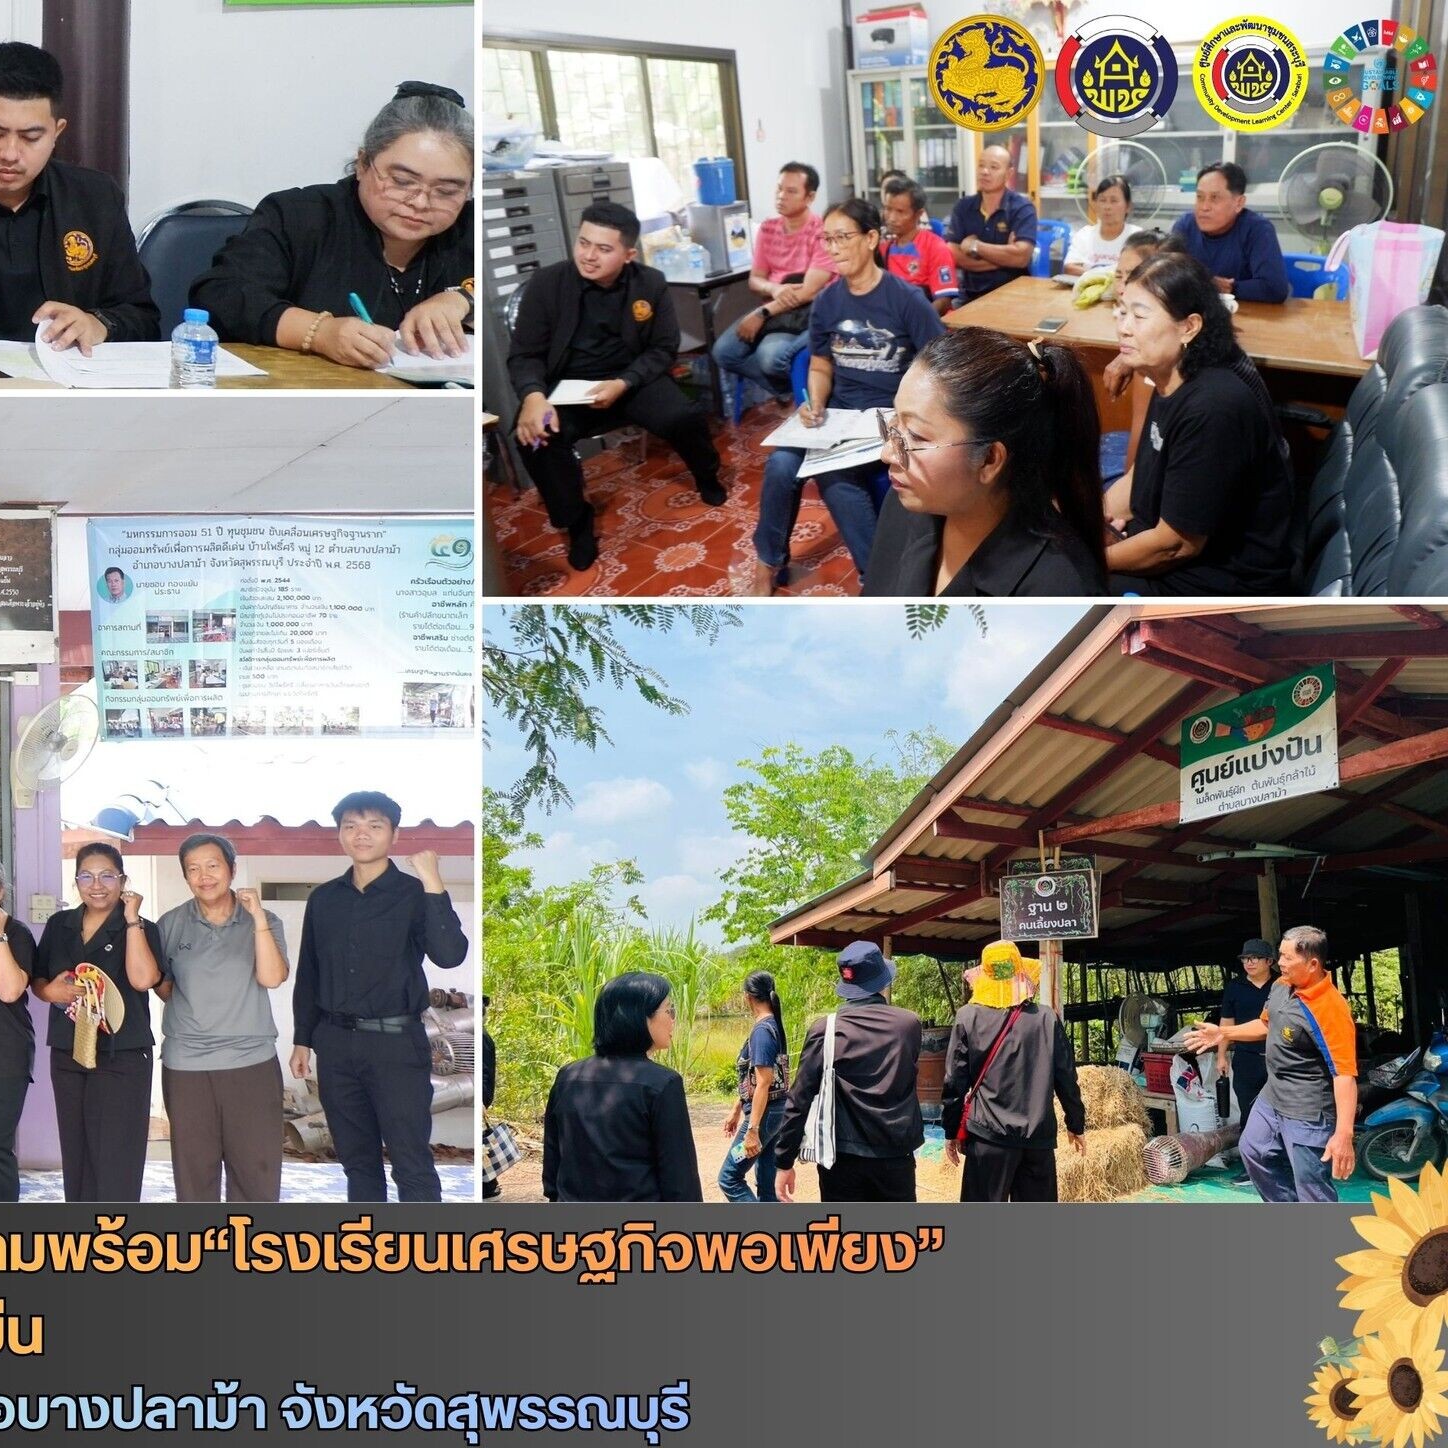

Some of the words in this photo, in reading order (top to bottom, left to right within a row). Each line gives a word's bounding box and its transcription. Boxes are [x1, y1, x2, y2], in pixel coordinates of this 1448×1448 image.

[216, 526, 224, 537] ปี
[226, 527, 265, 541] ทุนชุมชน
[108, 542, 246, 556] กลุ่มออมทรัพย์เพื่อการผลิตดีเด่น
[249, 538, 295, 552] บ้านโพธิ์ศรี
[298, 543, 312, 556] หมู่
[314, 544, 325, 553] 12
[328, 543, 401, 555] ตำบลบางปลาม้า
[132, 558, 208, 570] อำเภอบางปลาม้า
[210, 556, 284, 572] จังหวัดสุพรรณบุรี
[287, 556, 323, 568] ประจำปี
[346, 560, 371, 570] 2568
[1191, 734, 1323, 794] ศูนย์แบ่งปัน
[1218, 787, 1287, 813] ตำบลบางปลาม้า
[1027, 902, 1052, 916] ฐาน
[1056, 900, 1068, 911] ๒
[1019, 916, 1077, 930] คนเลี้ยงปลา
